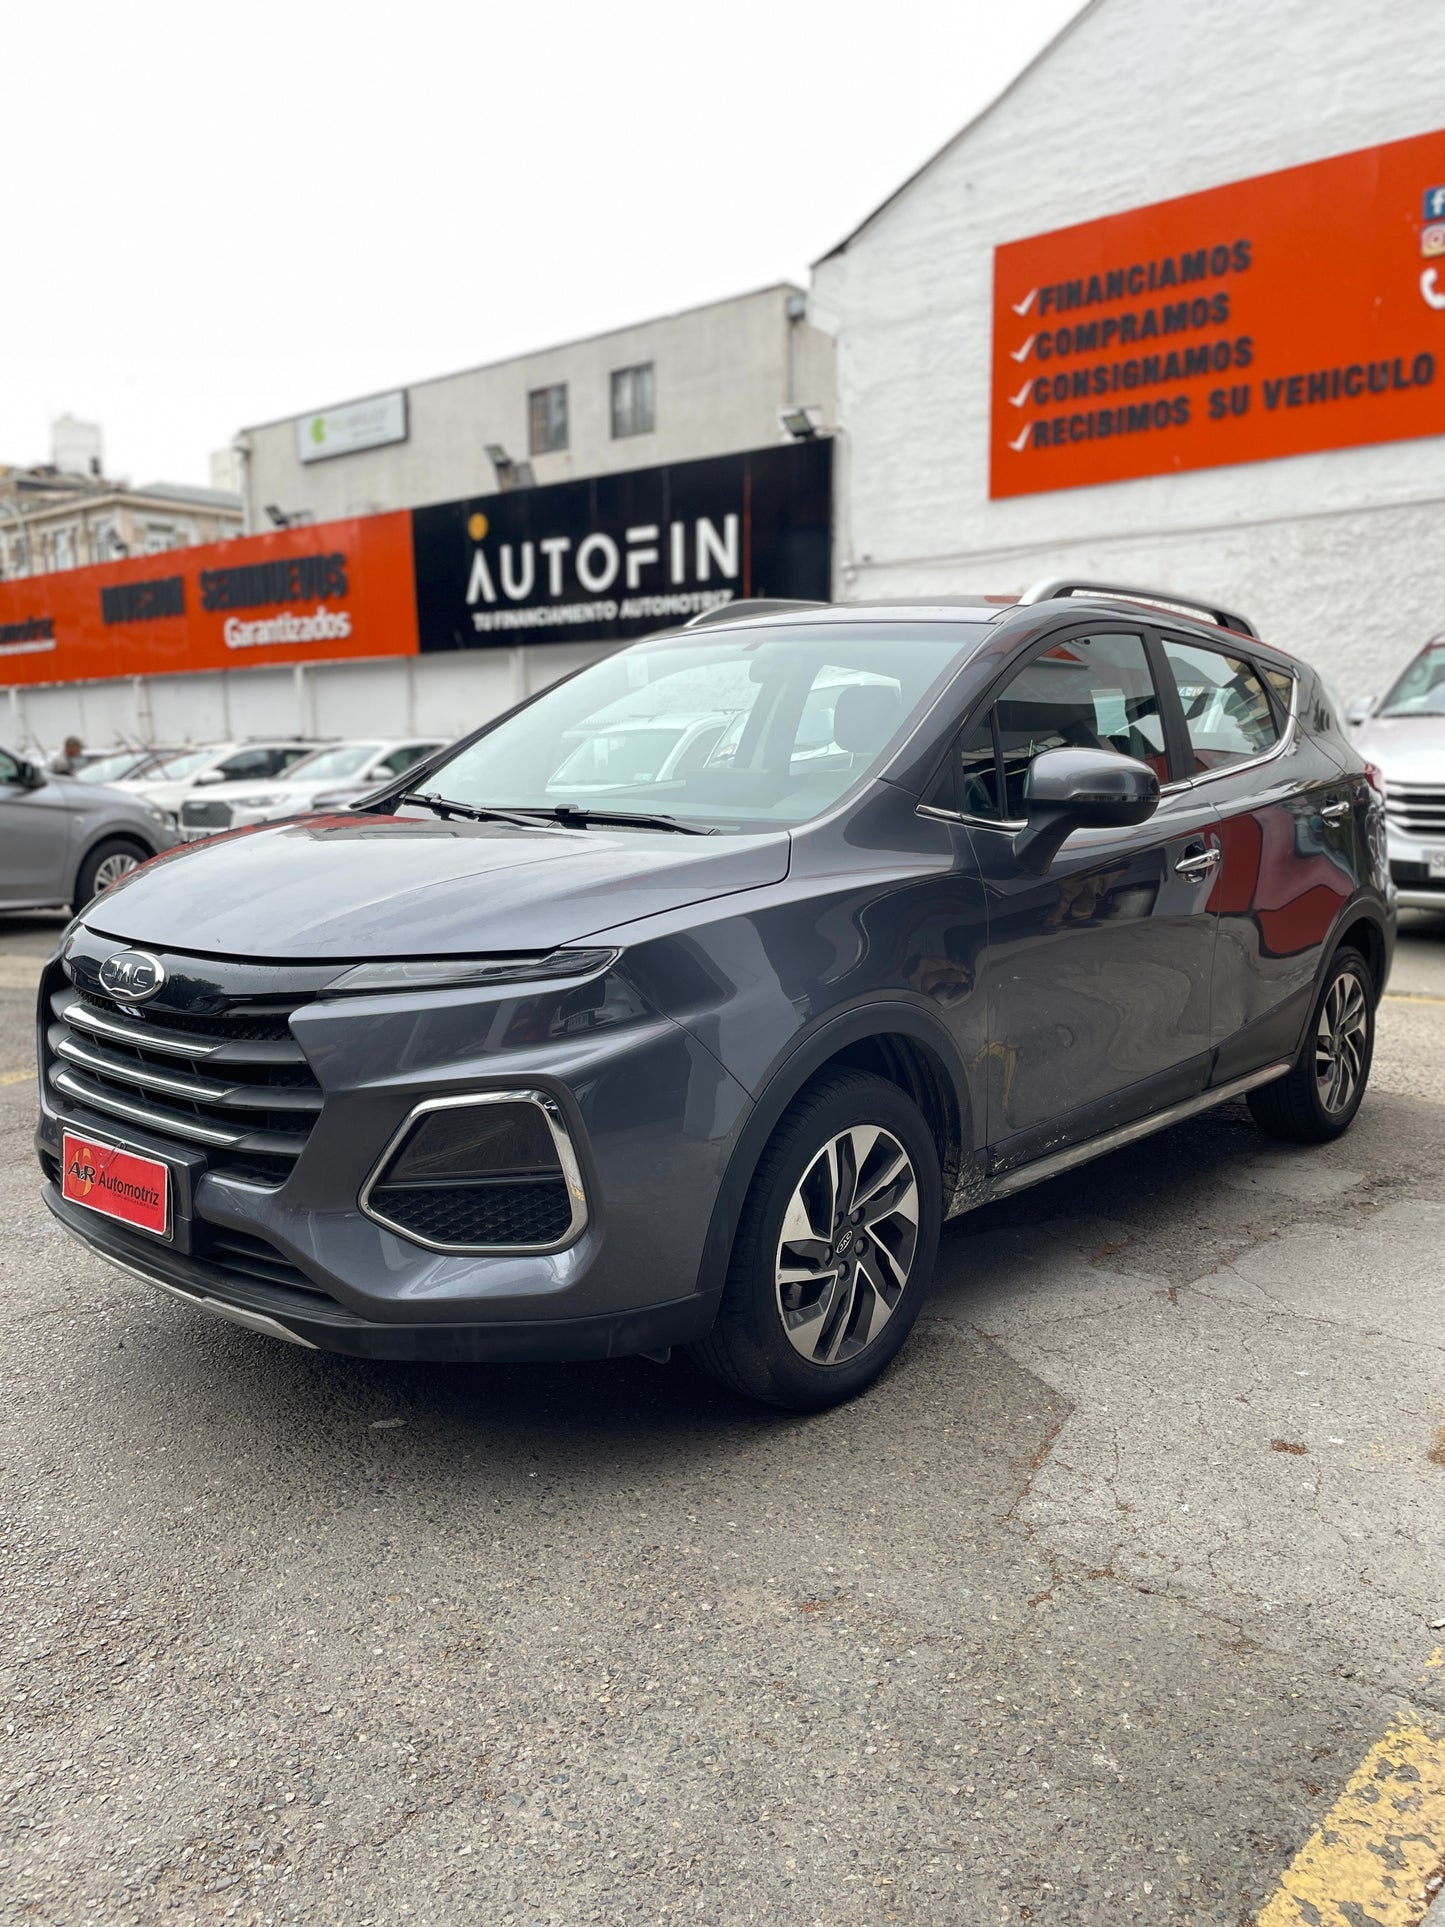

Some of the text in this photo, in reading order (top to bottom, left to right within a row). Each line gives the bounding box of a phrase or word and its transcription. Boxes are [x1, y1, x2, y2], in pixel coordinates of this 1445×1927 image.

[1038, 240, 1252, 316] FINANCIAMOS
[1034, 293, 1231, 361] COMPRAMOS
[1032, 337, 1253, 404] CONSIGNAMOS
[1032, 353, 1435, 449] RECIBIMOS SU VEHICULO
[466, 513, 739, 604] AUTOFIN
[223, 606, 351, 649] Garantizados
[472, 611, 494, 632] TU
[620, 589, 733, 619] AUTOMOTRIZ
[105, 960, 152, 987] JAC
[98, 1171, 160, 1206] Automotriz
